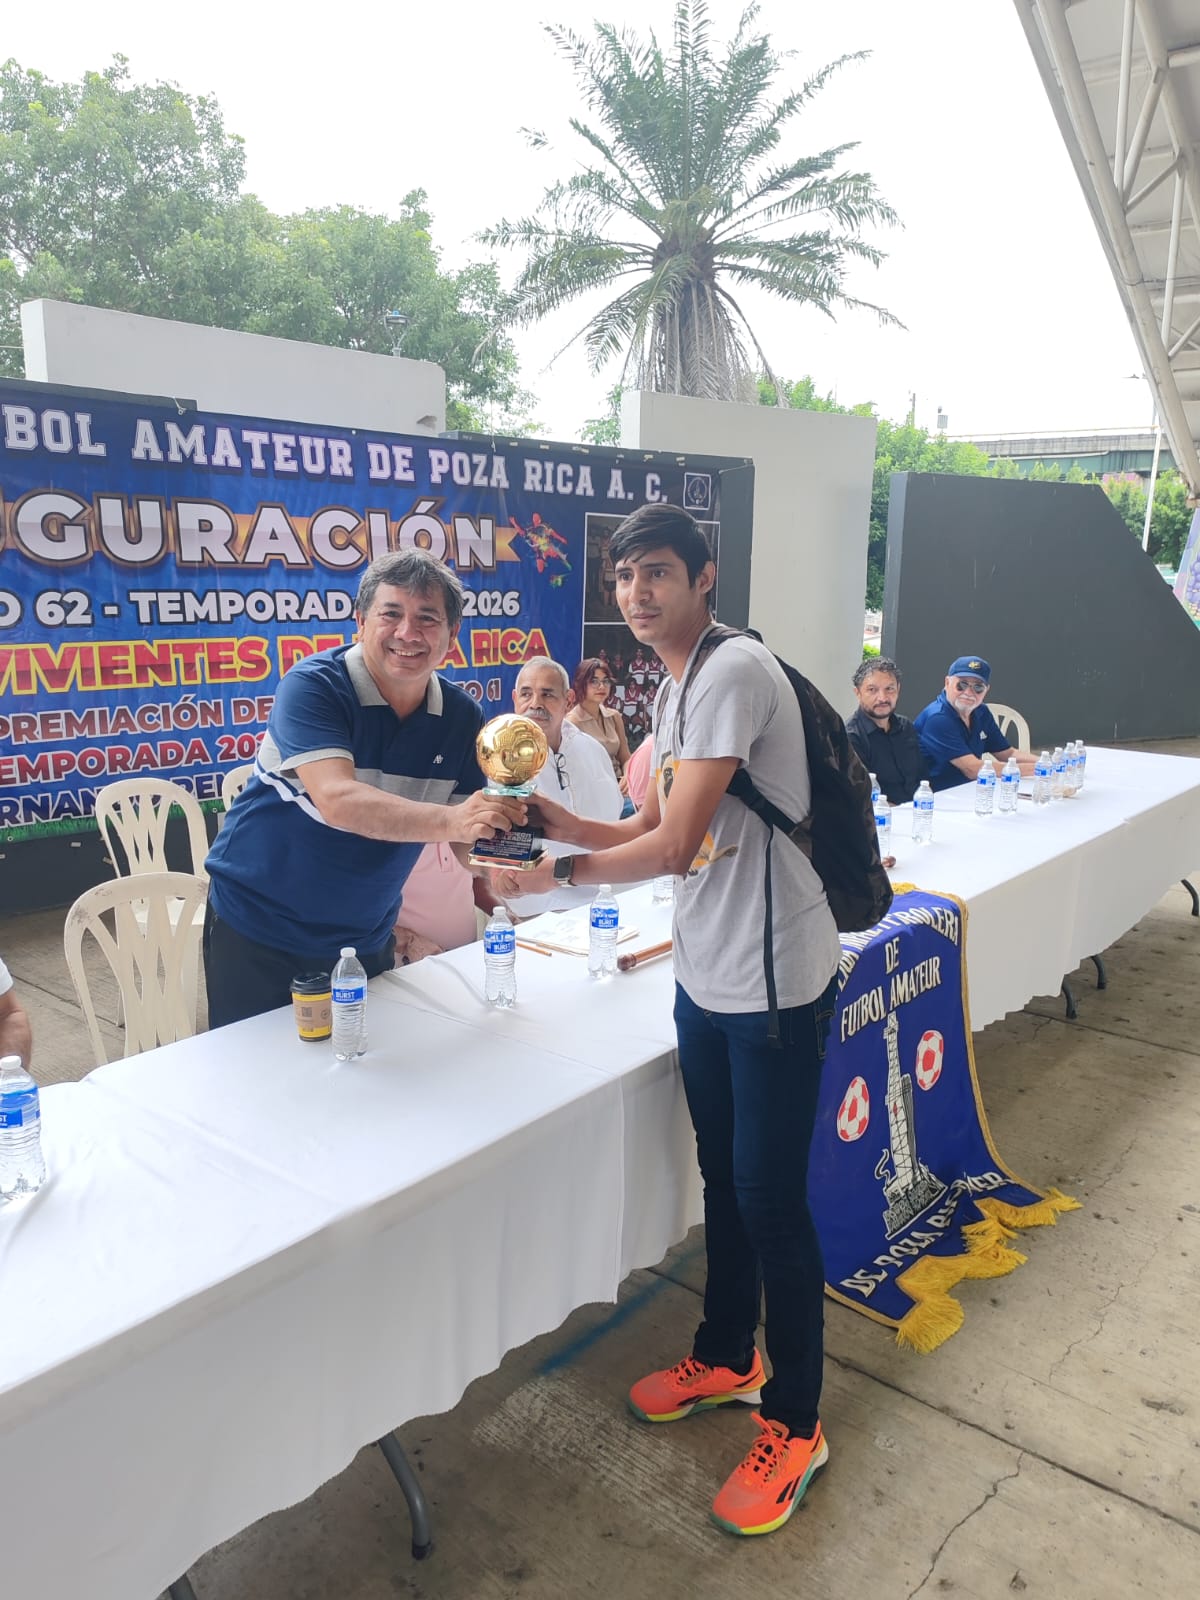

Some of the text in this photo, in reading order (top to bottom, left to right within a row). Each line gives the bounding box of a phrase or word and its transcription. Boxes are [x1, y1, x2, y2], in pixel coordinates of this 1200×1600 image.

[2, 404, 106, 456] BOL
[132, 419, 354, 477] AMATEUR
[367, 442, 416, 482] DE
[429, 449, 509, 488] POZA
[524, 458, 594, 496] RICA
[607, 469, 634, 500] A.
[645, 473, 668, 503] C.
[13, 488, 497, 571] GURACIÓN
[36, 591, 92, 625] 62
[130, 591, 356, 622] TEMPORAD
[462, 590, 520, 616] 2026
[471, 628, 552, 667] RICA
[0, 738, 212, 787] EMPORADA
[885, 937, 899, 974] DE
[841, 956, 941, 1042] FUTBOL AMATEUR
[840, 1269, 888, 1298] DE
